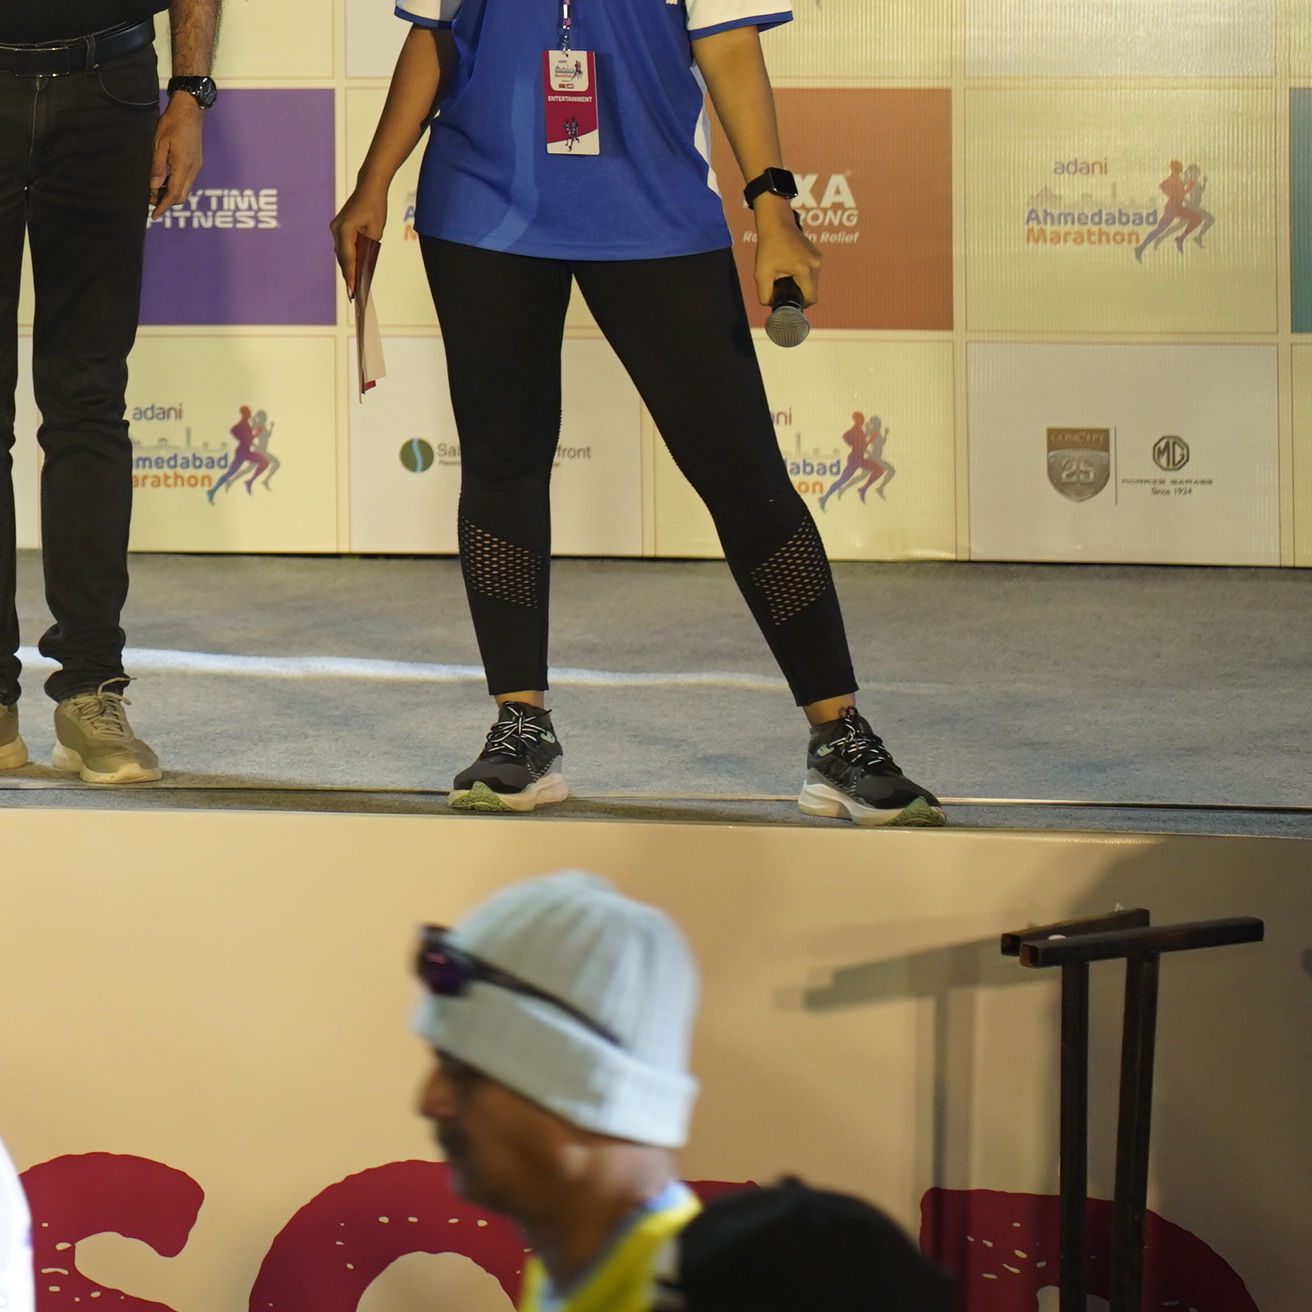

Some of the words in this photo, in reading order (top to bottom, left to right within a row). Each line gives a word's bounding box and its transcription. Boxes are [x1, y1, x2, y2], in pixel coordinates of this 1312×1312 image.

[1053, 157, 1107, 177] adani
[1026, 208, 1157, 226] Ahmedabad
[820, 231, 859, 243] Relief
[1026, 227, 1140, 246] Marathon
[132, 403, 183, 421] adani
[134, 452, 229, 469] medabad
[1157, 440, 1185, 467] MG
[132, 473, 213, 488] arathon
